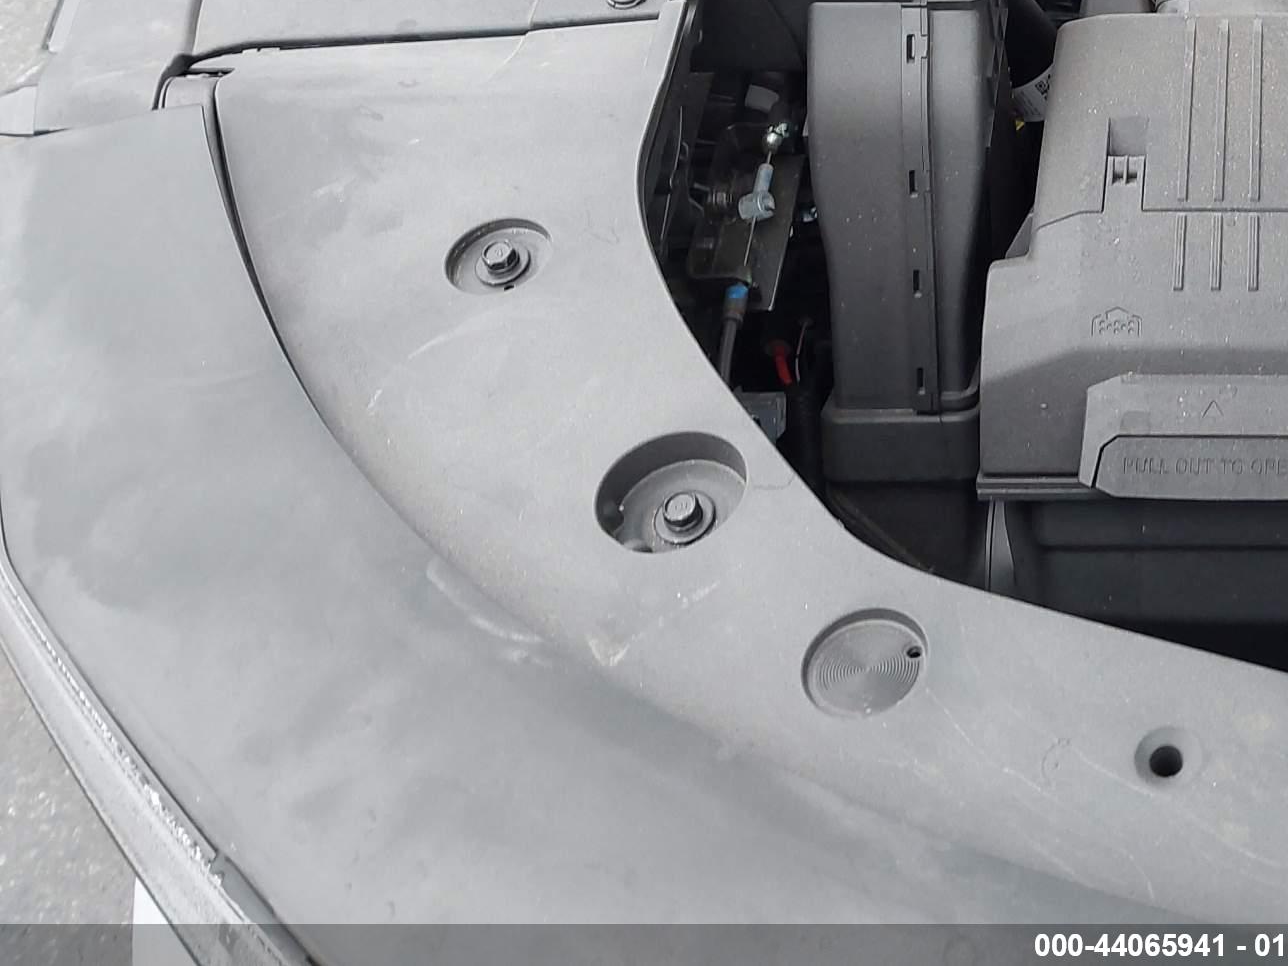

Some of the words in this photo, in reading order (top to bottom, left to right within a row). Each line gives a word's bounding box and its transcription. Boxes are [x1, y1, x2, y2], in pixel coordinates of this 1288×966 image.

[1122, 457, 1169, 475] PULL
[1176, 457, 1213, 475] OUT
[1220, 457, 1243, 475] TO
